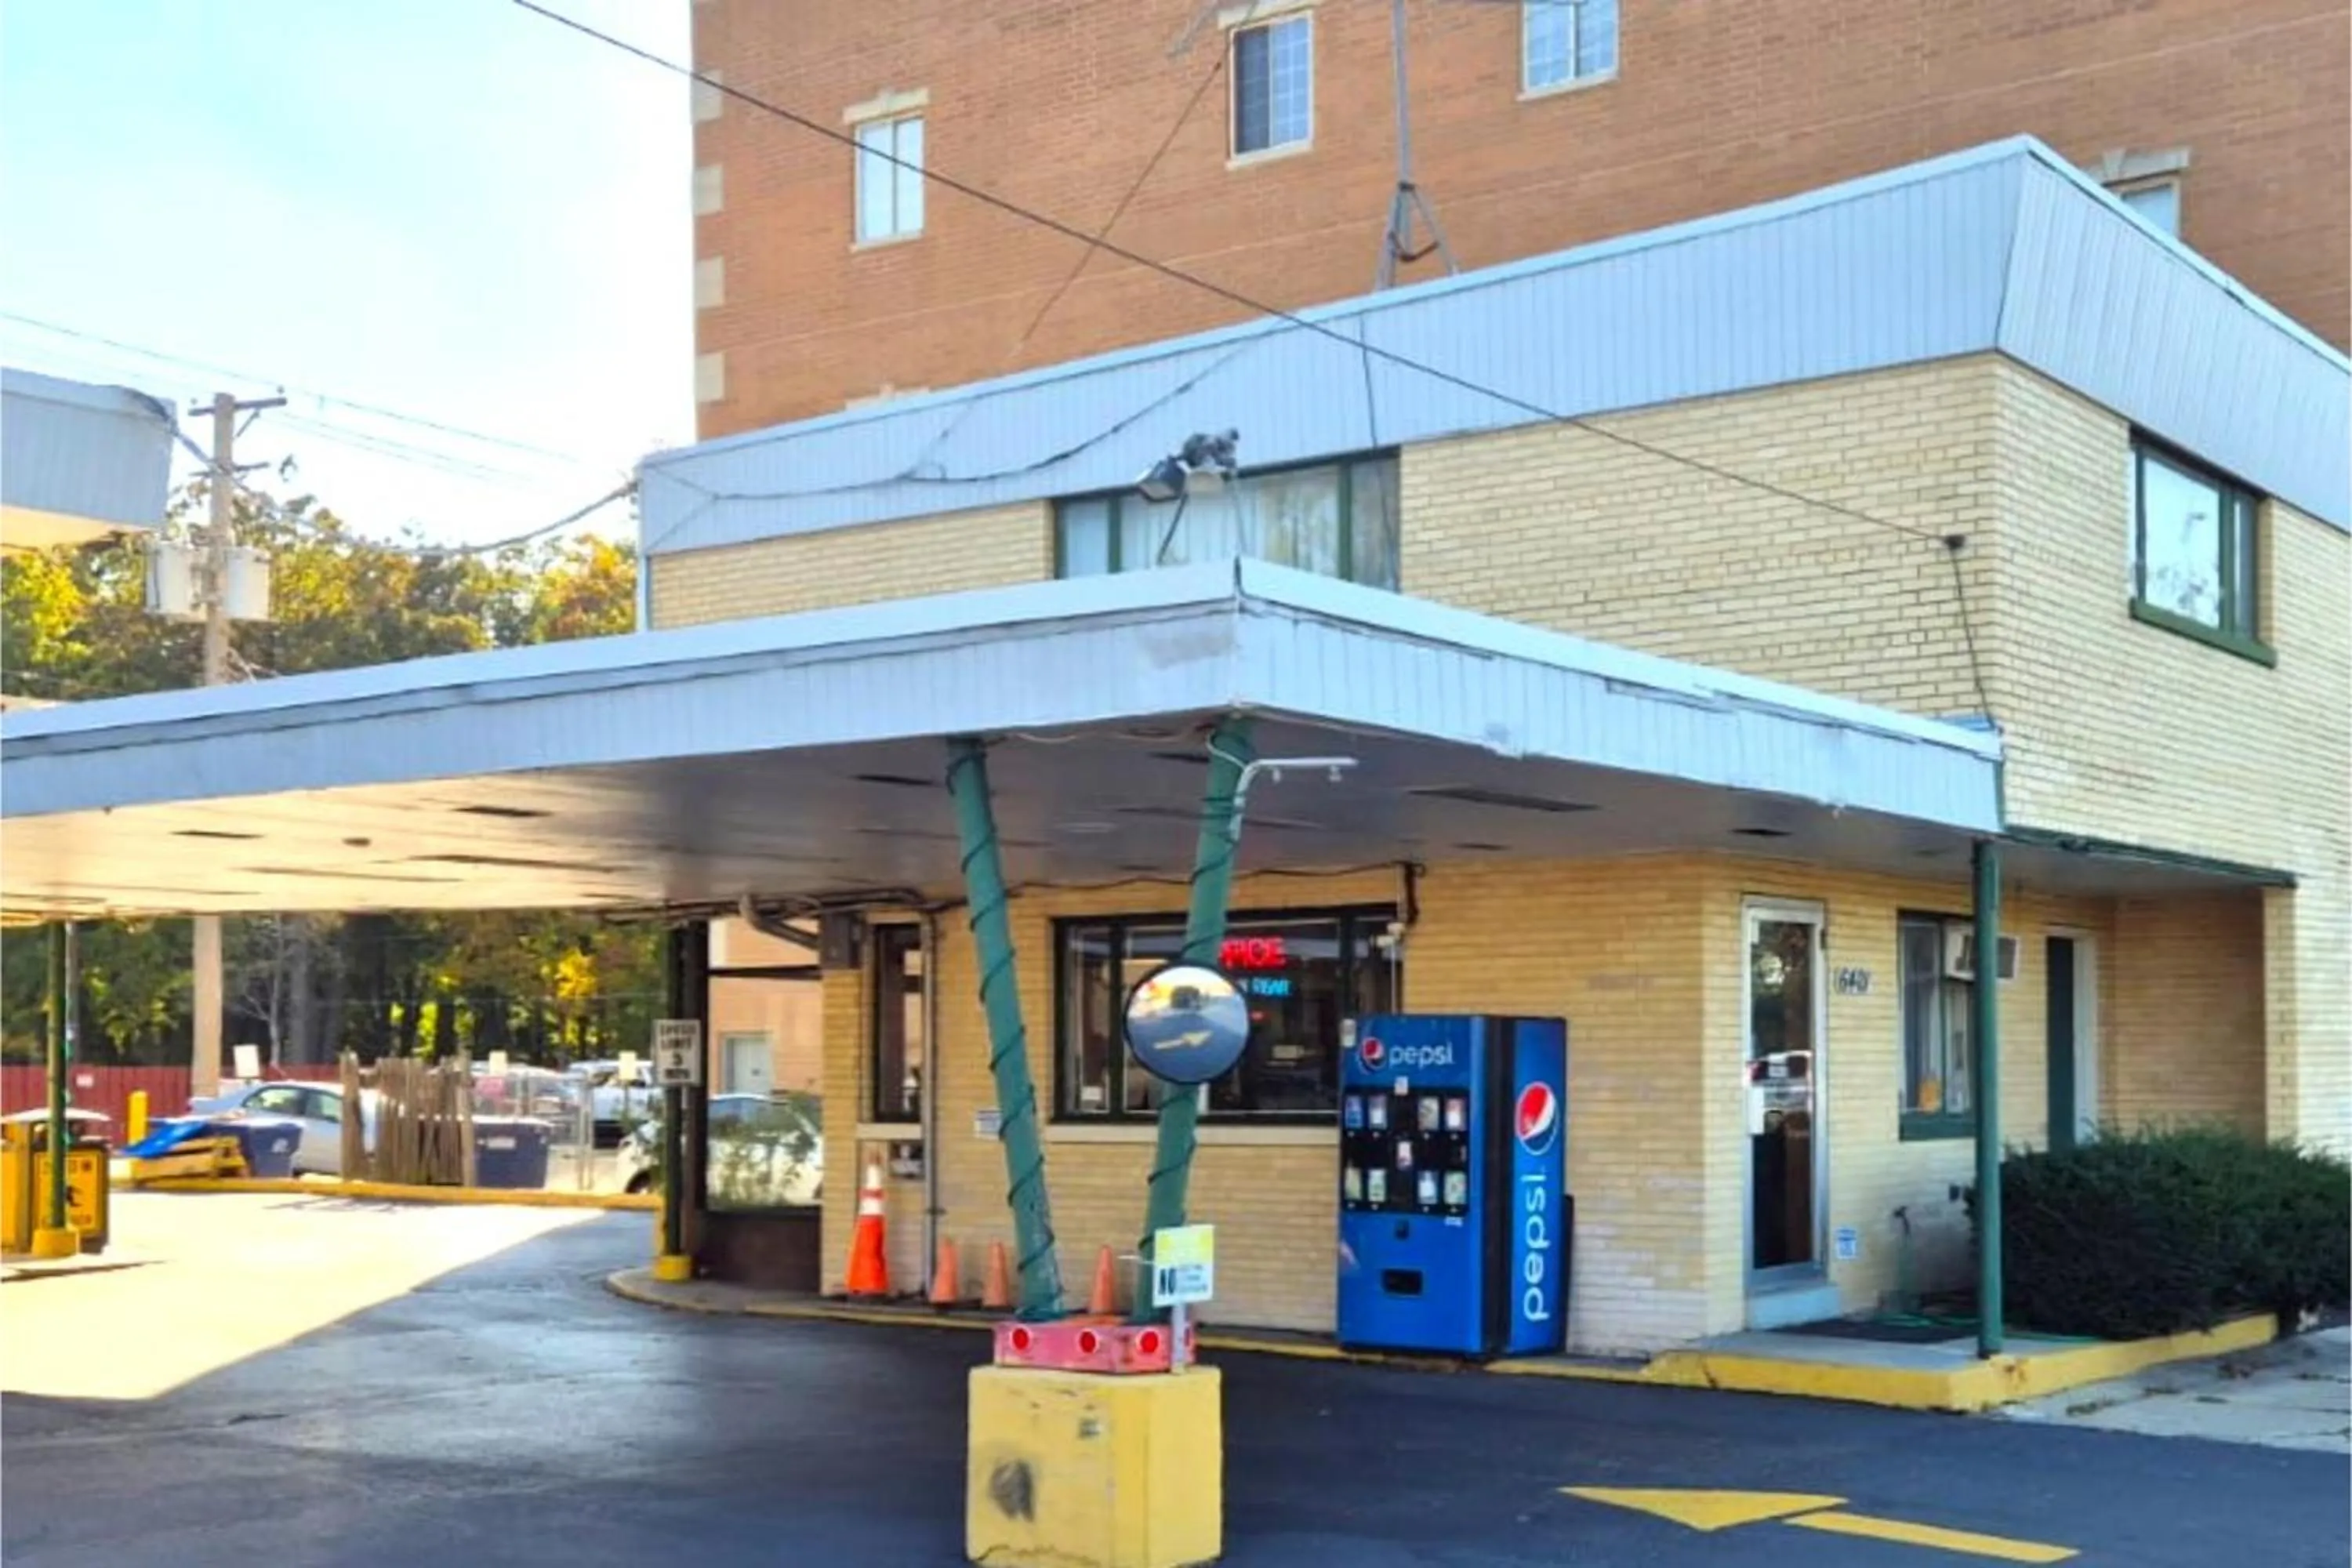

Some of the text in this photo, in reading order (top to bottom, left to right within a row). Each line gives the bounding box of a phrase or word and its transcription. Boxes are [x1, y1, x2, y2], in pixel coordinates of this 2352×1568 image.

[660, 1037, 691, 1050] LIMIT
[1388, 1041, 1454, 1069] pepsi
[1522, 1174, 1551, 1322] pepsi
